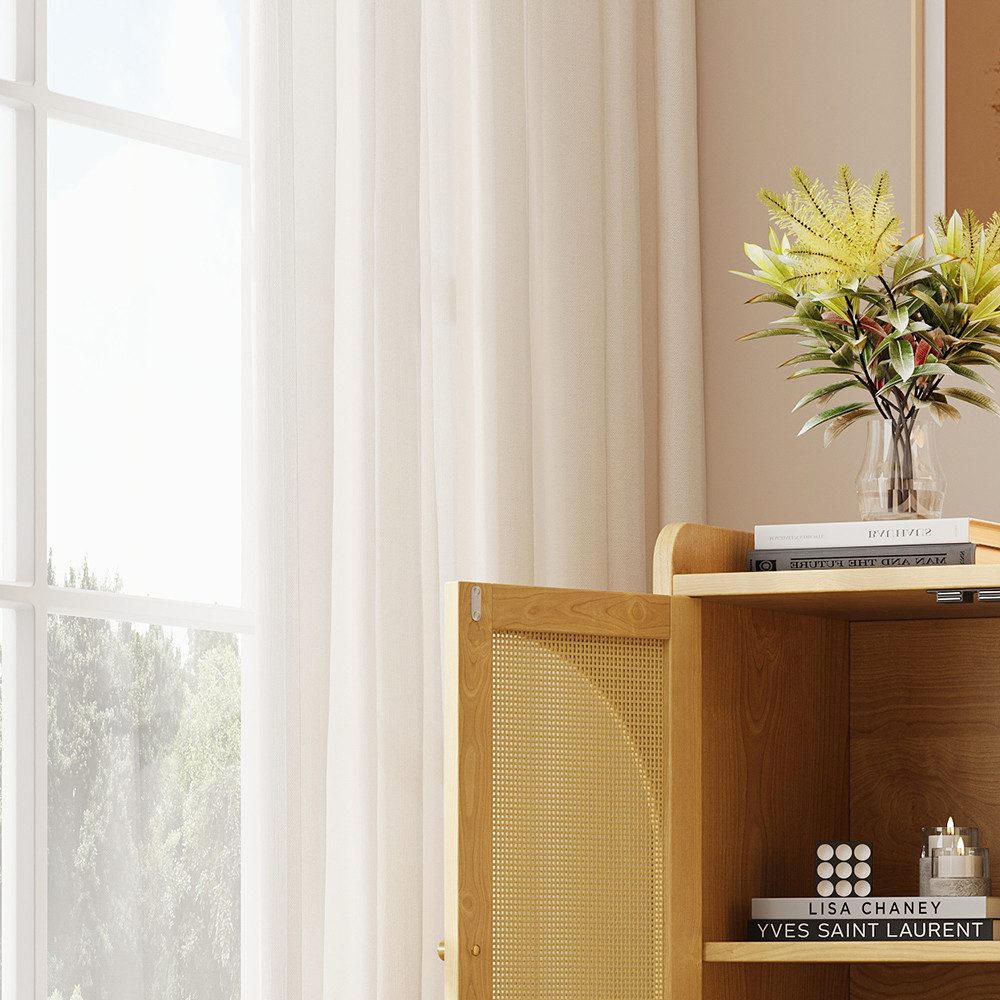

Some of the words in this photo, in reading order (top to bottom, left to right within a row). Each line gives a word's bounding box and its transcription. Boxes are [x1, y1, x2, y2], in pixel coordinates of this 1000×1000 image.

[809, 901, 851, 915] LISA
[861, 901, 942, 915] CHANEY
[757, 922, 810, 938] YVES
[817, 922, 880, 938] SAINT
[886, 921, 984, 938] LAURENT
